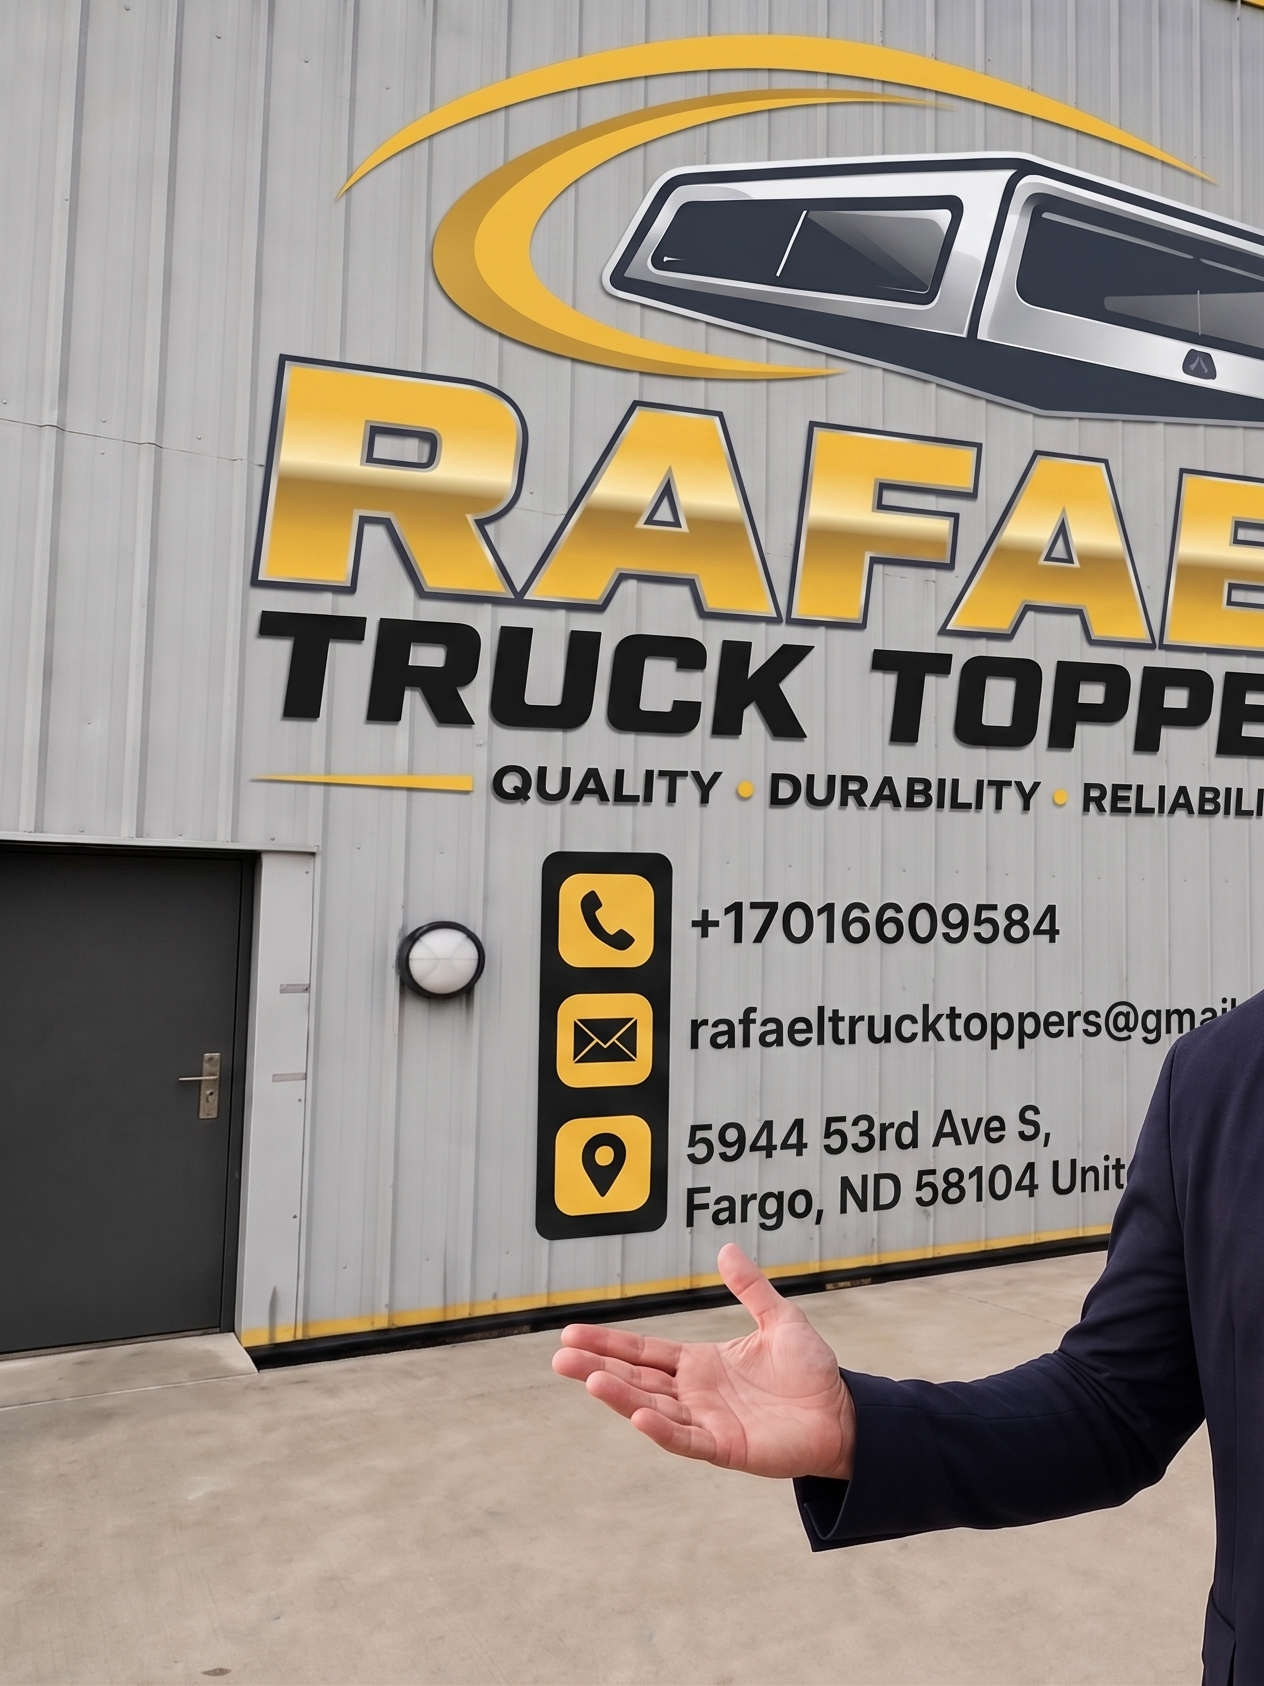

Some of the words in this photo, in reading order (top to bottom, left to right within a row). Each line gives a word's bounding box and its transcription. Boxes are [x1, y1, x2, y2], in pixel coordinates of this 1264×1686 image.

[258, 610, 815, 741] TRUCK
[492, 764, 723, 805] QUALITY
[769, 772, 1041, 812] DURABILITY
[691, 901, 1060, 944] +17016609584
[686, 1117, 808, 1165] 5944
[823, 1110, 919, 1156] 53rd
[932, 1109, 1006, 1148] Ave
[1017, 1104, 1051, 1148] S,
[686, 1186, 824, 1232] Fargo,
[840, 1172, 902, 1215] ND
[915, 1161, 1039, 1208] 58104
[1052, 1154, 1126, 1196] Unit
